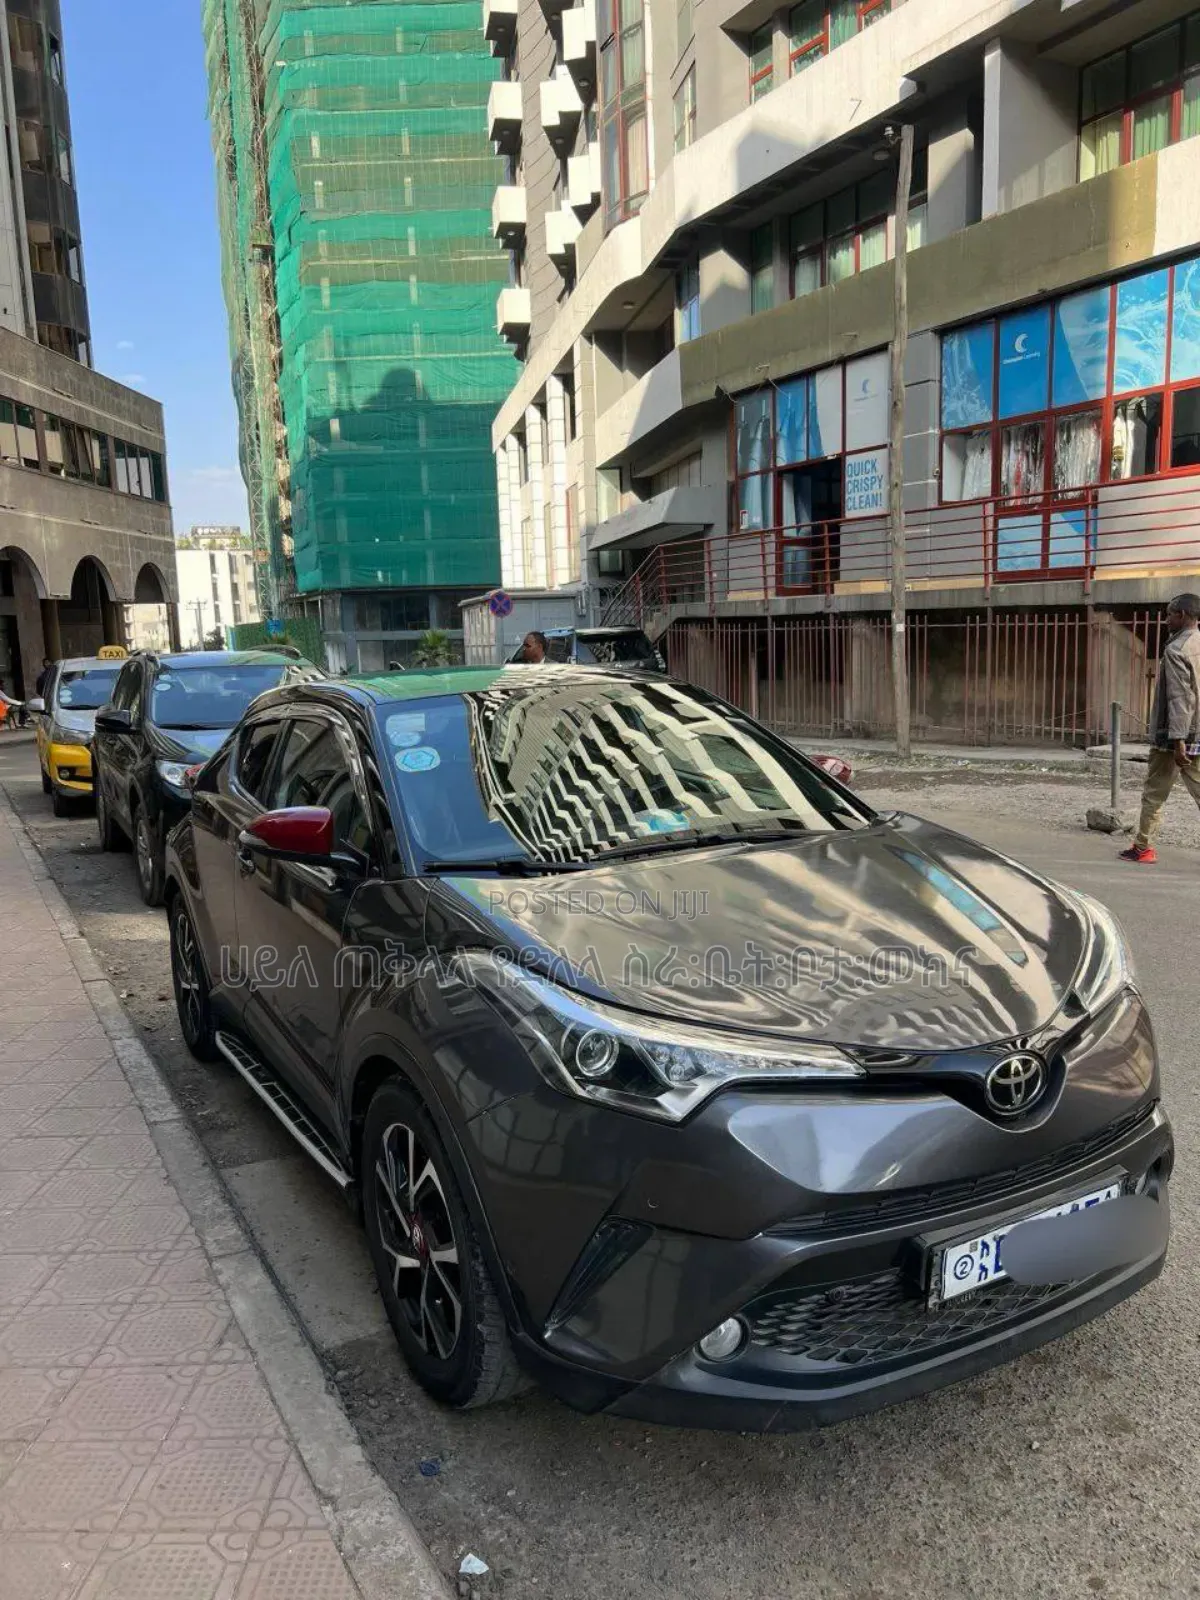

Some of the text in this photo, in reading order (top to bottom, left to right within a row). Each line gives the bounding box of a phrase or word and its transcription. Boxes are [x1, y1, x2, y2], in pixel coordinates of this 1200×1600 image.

[847, 458, 877, 478] QUICK
[847, 475, 883, 495] CRISPY
[847, 492, 882, 511] CLEAN!
[102, 650, 124, 658] TAXI
